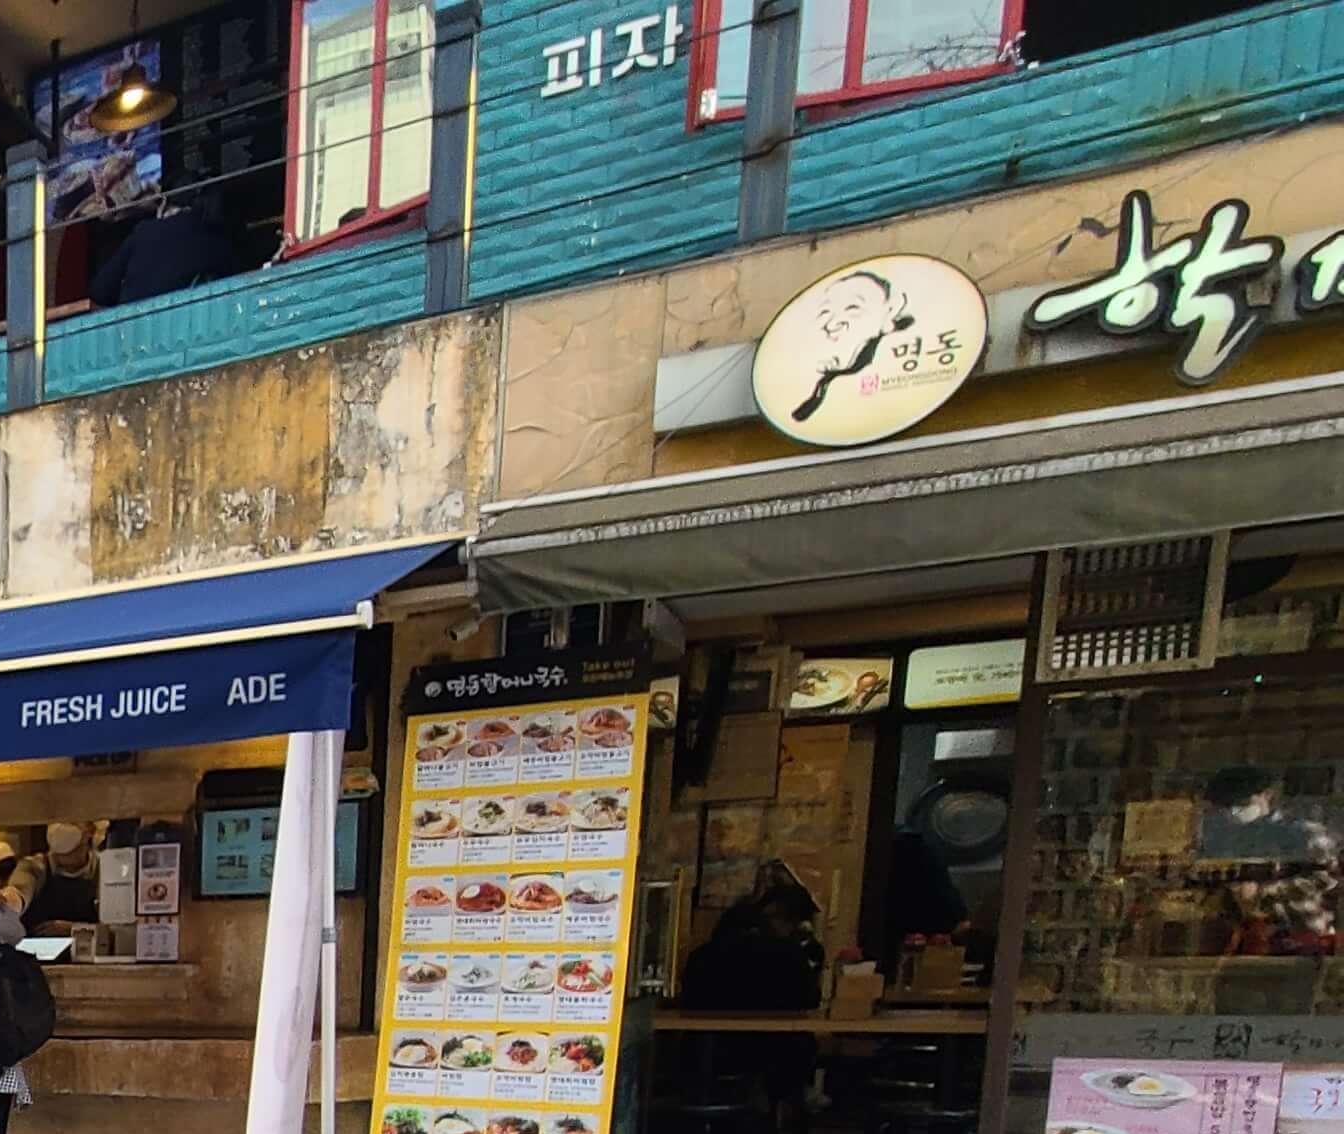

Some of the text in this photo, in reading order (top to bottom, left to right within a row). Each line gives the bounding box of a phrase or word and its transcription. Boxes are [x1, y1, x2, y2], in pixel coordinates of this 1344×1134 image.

[539, 6, 684, 99] 피자
[892, 329, 963, 372] 명동
[20, 673, 288, 729] FRESH JUICE ADE
